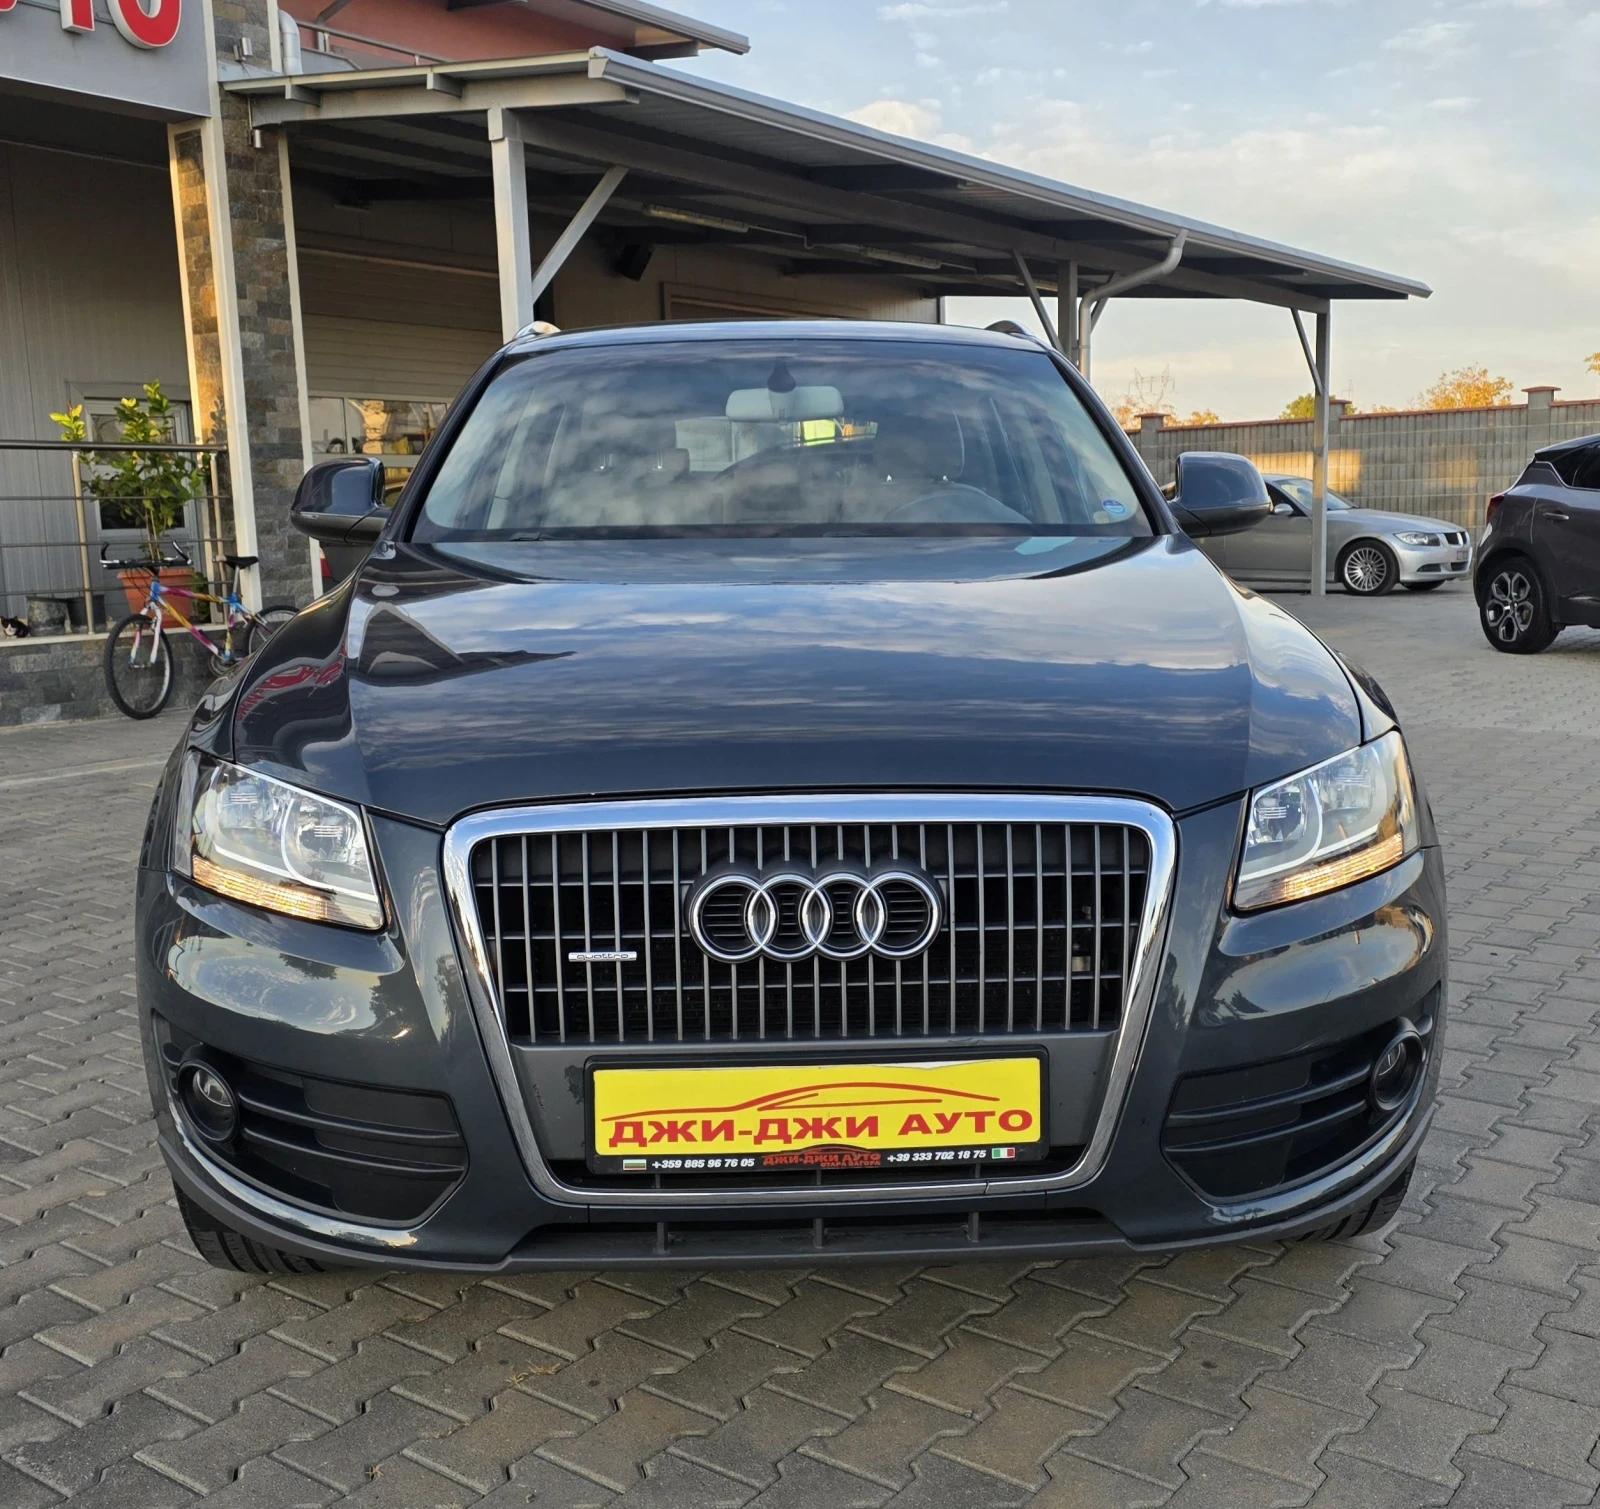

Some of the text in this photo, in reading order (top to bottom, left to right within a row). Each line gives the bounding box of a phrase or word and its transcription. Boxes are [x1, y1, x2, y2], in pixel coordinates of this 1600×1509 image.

[577, 953, 629, 961] quattro
[609, 1109, 1033, 1147] ДЖИ-ДЖИ АУТО
[763, 1152, 882, 1166] ДЖИ-ДЖИ АУТО
[887, 1150, 987, 1162] +39 333 702 18 75
[652, 1158, 755, 1169] +359 885 96 76 05
